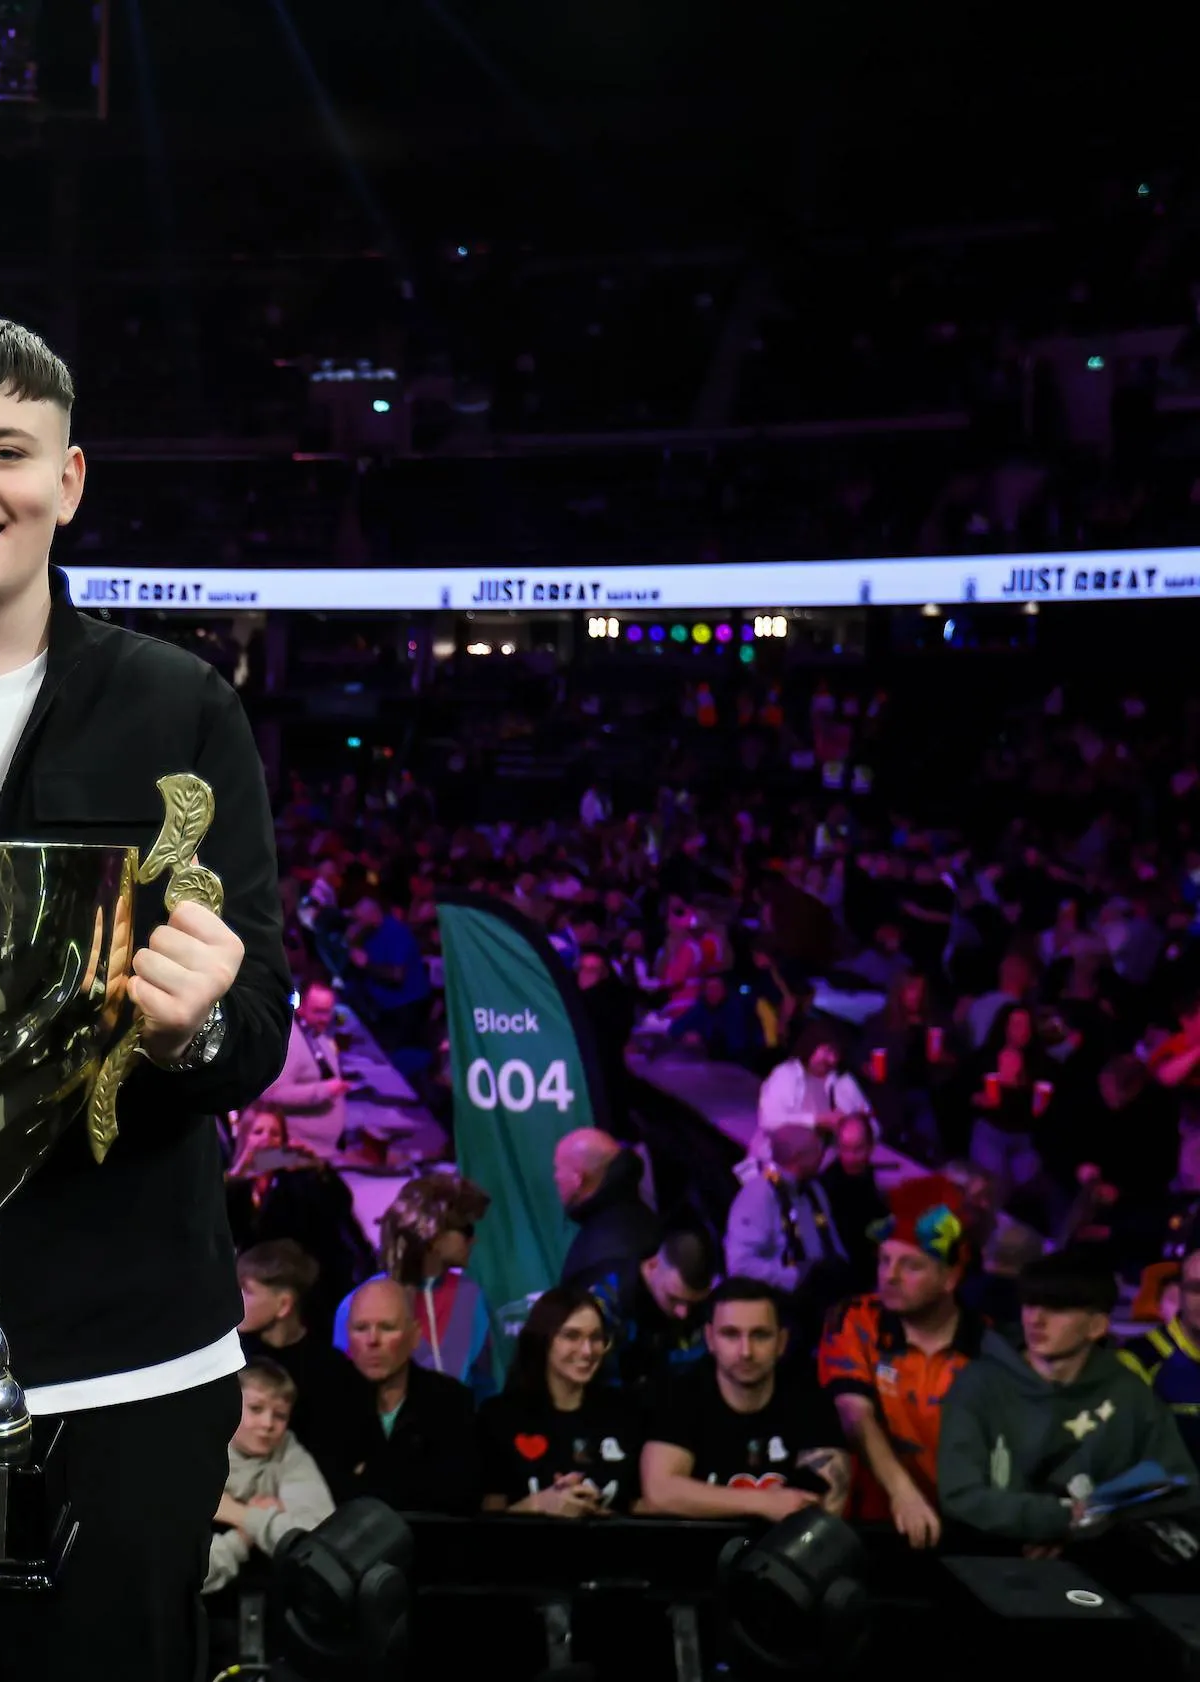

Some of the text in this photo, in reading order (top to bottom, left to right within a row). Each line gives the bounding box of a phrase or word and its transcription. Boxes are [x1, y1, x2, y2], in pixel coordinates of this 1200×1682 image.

[81, 579, 131, 600] JUST
[138, 583, 202, 601] GREAT
[473, 579, 525, 601] JUST
[533, 583, 600, 601] GREAT
[1003, 567, 1065, 592] JUST
[1075, 568, 1156, 590] GREAT
[473, 1007, 539, 1034] Block
[467, 1058, 575, 1112] 004
